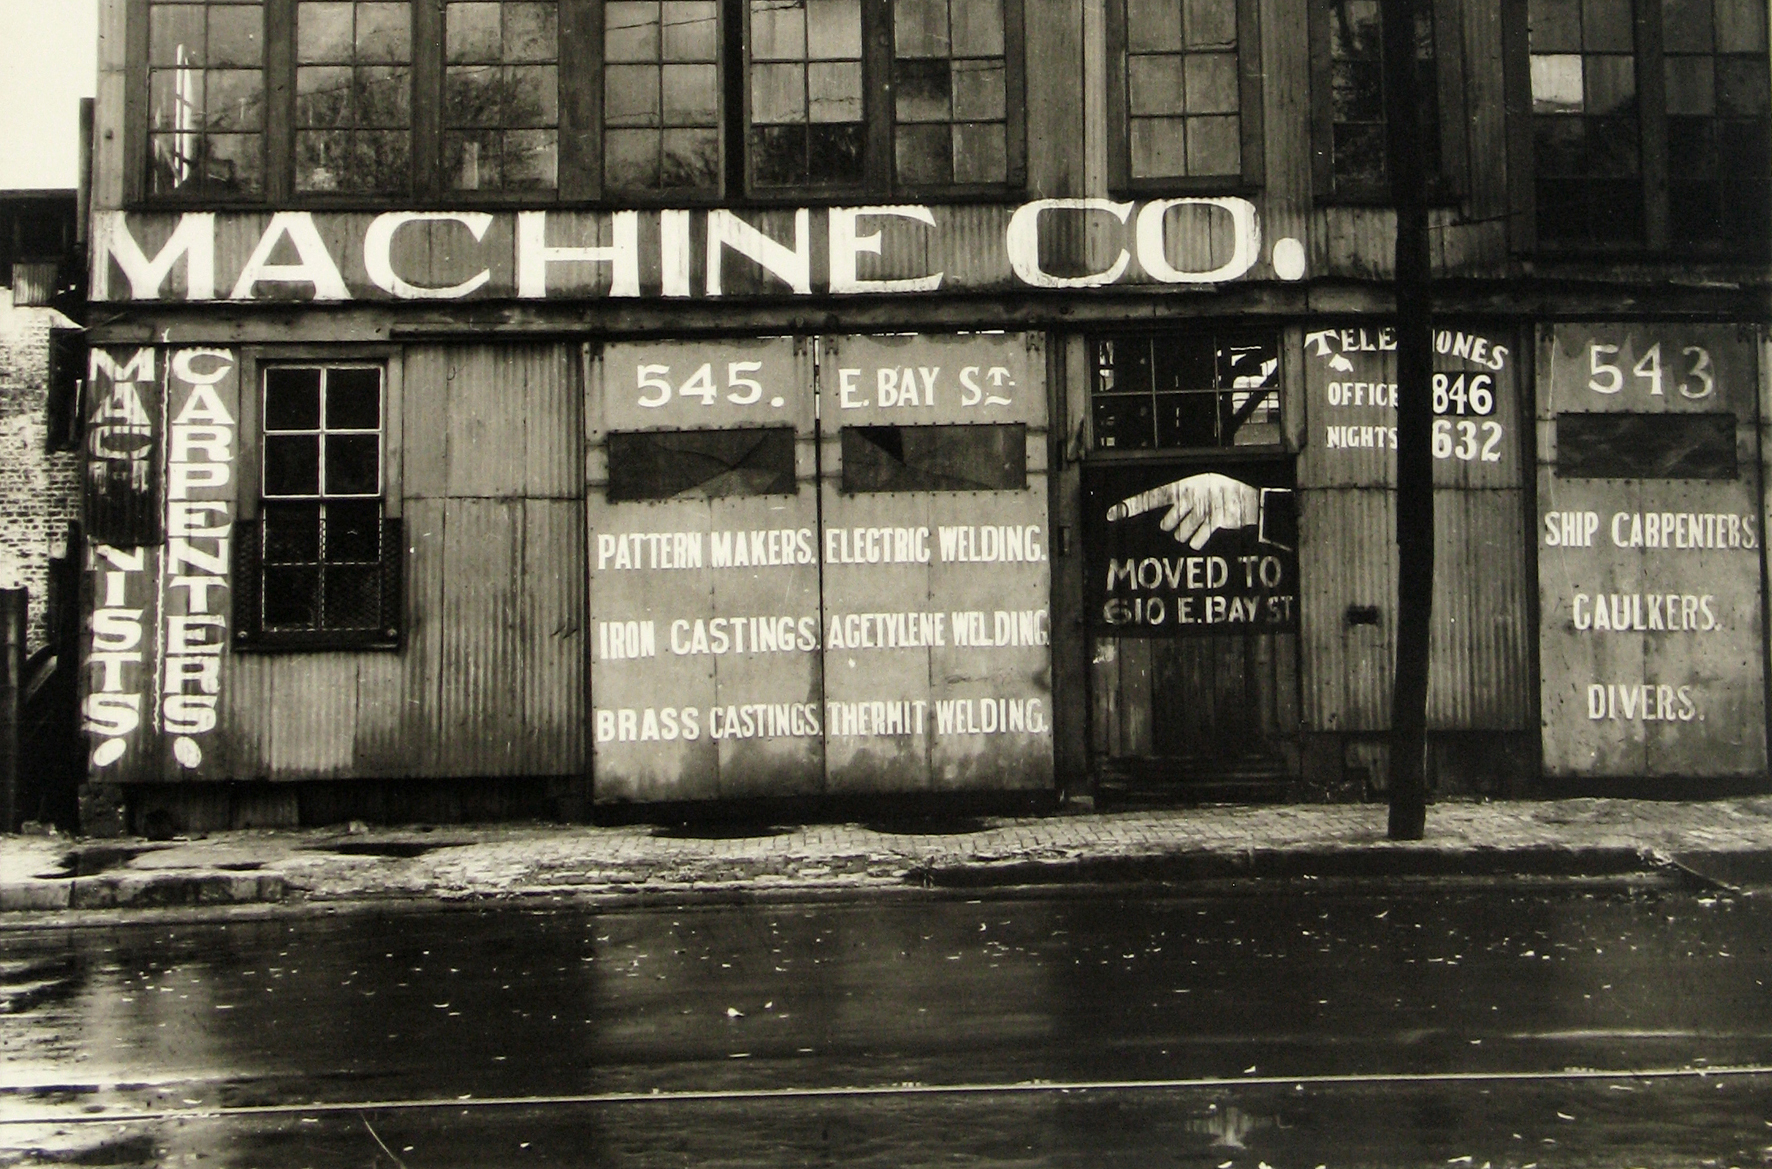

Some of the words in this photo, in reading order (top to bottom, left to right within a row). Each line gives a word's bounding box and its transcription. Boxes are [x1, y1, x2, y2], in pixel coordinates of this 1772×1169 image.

[88, 204, 943, 301] MACHINE
[1006, 196, 1306, 288] CO.
[1303, 328, 1508, 370] TELEONES
[637, 361, 786, 408] 545.
[1588, 344, 1715, 400] 543
[1327, 382, 1398, 407] OFFICE
[1432, 373, 1493, 416] 846
[1326, 425, 1398, 449] NIGHTS
[1431, 419, 1503, 462] 632
[598, 532, 702, 569] PATTERN
[711, 529, 816, 567] MAKERS.
[826, 528, 930, 564] ELECTRIC
[938, 525, 1048, 562] WELDING.
[1544, 511, 1599, 547] SHIP
[1611, 512, 1759, 549] CARPENTERS.
[81, 346, 156, 767] MACHNISTS.
[163, 346, 235, 768] CARPENTERS.
[1106, 556, 1229, 591] MOVED
[1237, 555, 1282, 588] TO
[828, 613, 945, 649] ACETYLENE
[952, 610, 1050, 647] WELDING.
[1103, 597, 1166, 625] 610
[1266, 595, 1294, 622] ST
[1573, 593, 1723, 631] CAULKERS.
[600, 621, 655, 659] IRON
[671, 616, 820, 655] CASTINGS.
[597, 708, 699, 742] BRASS
[710, 703, 823, 739] CASTINGS.
[828, 700, 926, 735] THERMIT
[935, 698, 1049, 734] WELDING.
[1587, 684, 1705, 721] DIVERS.
